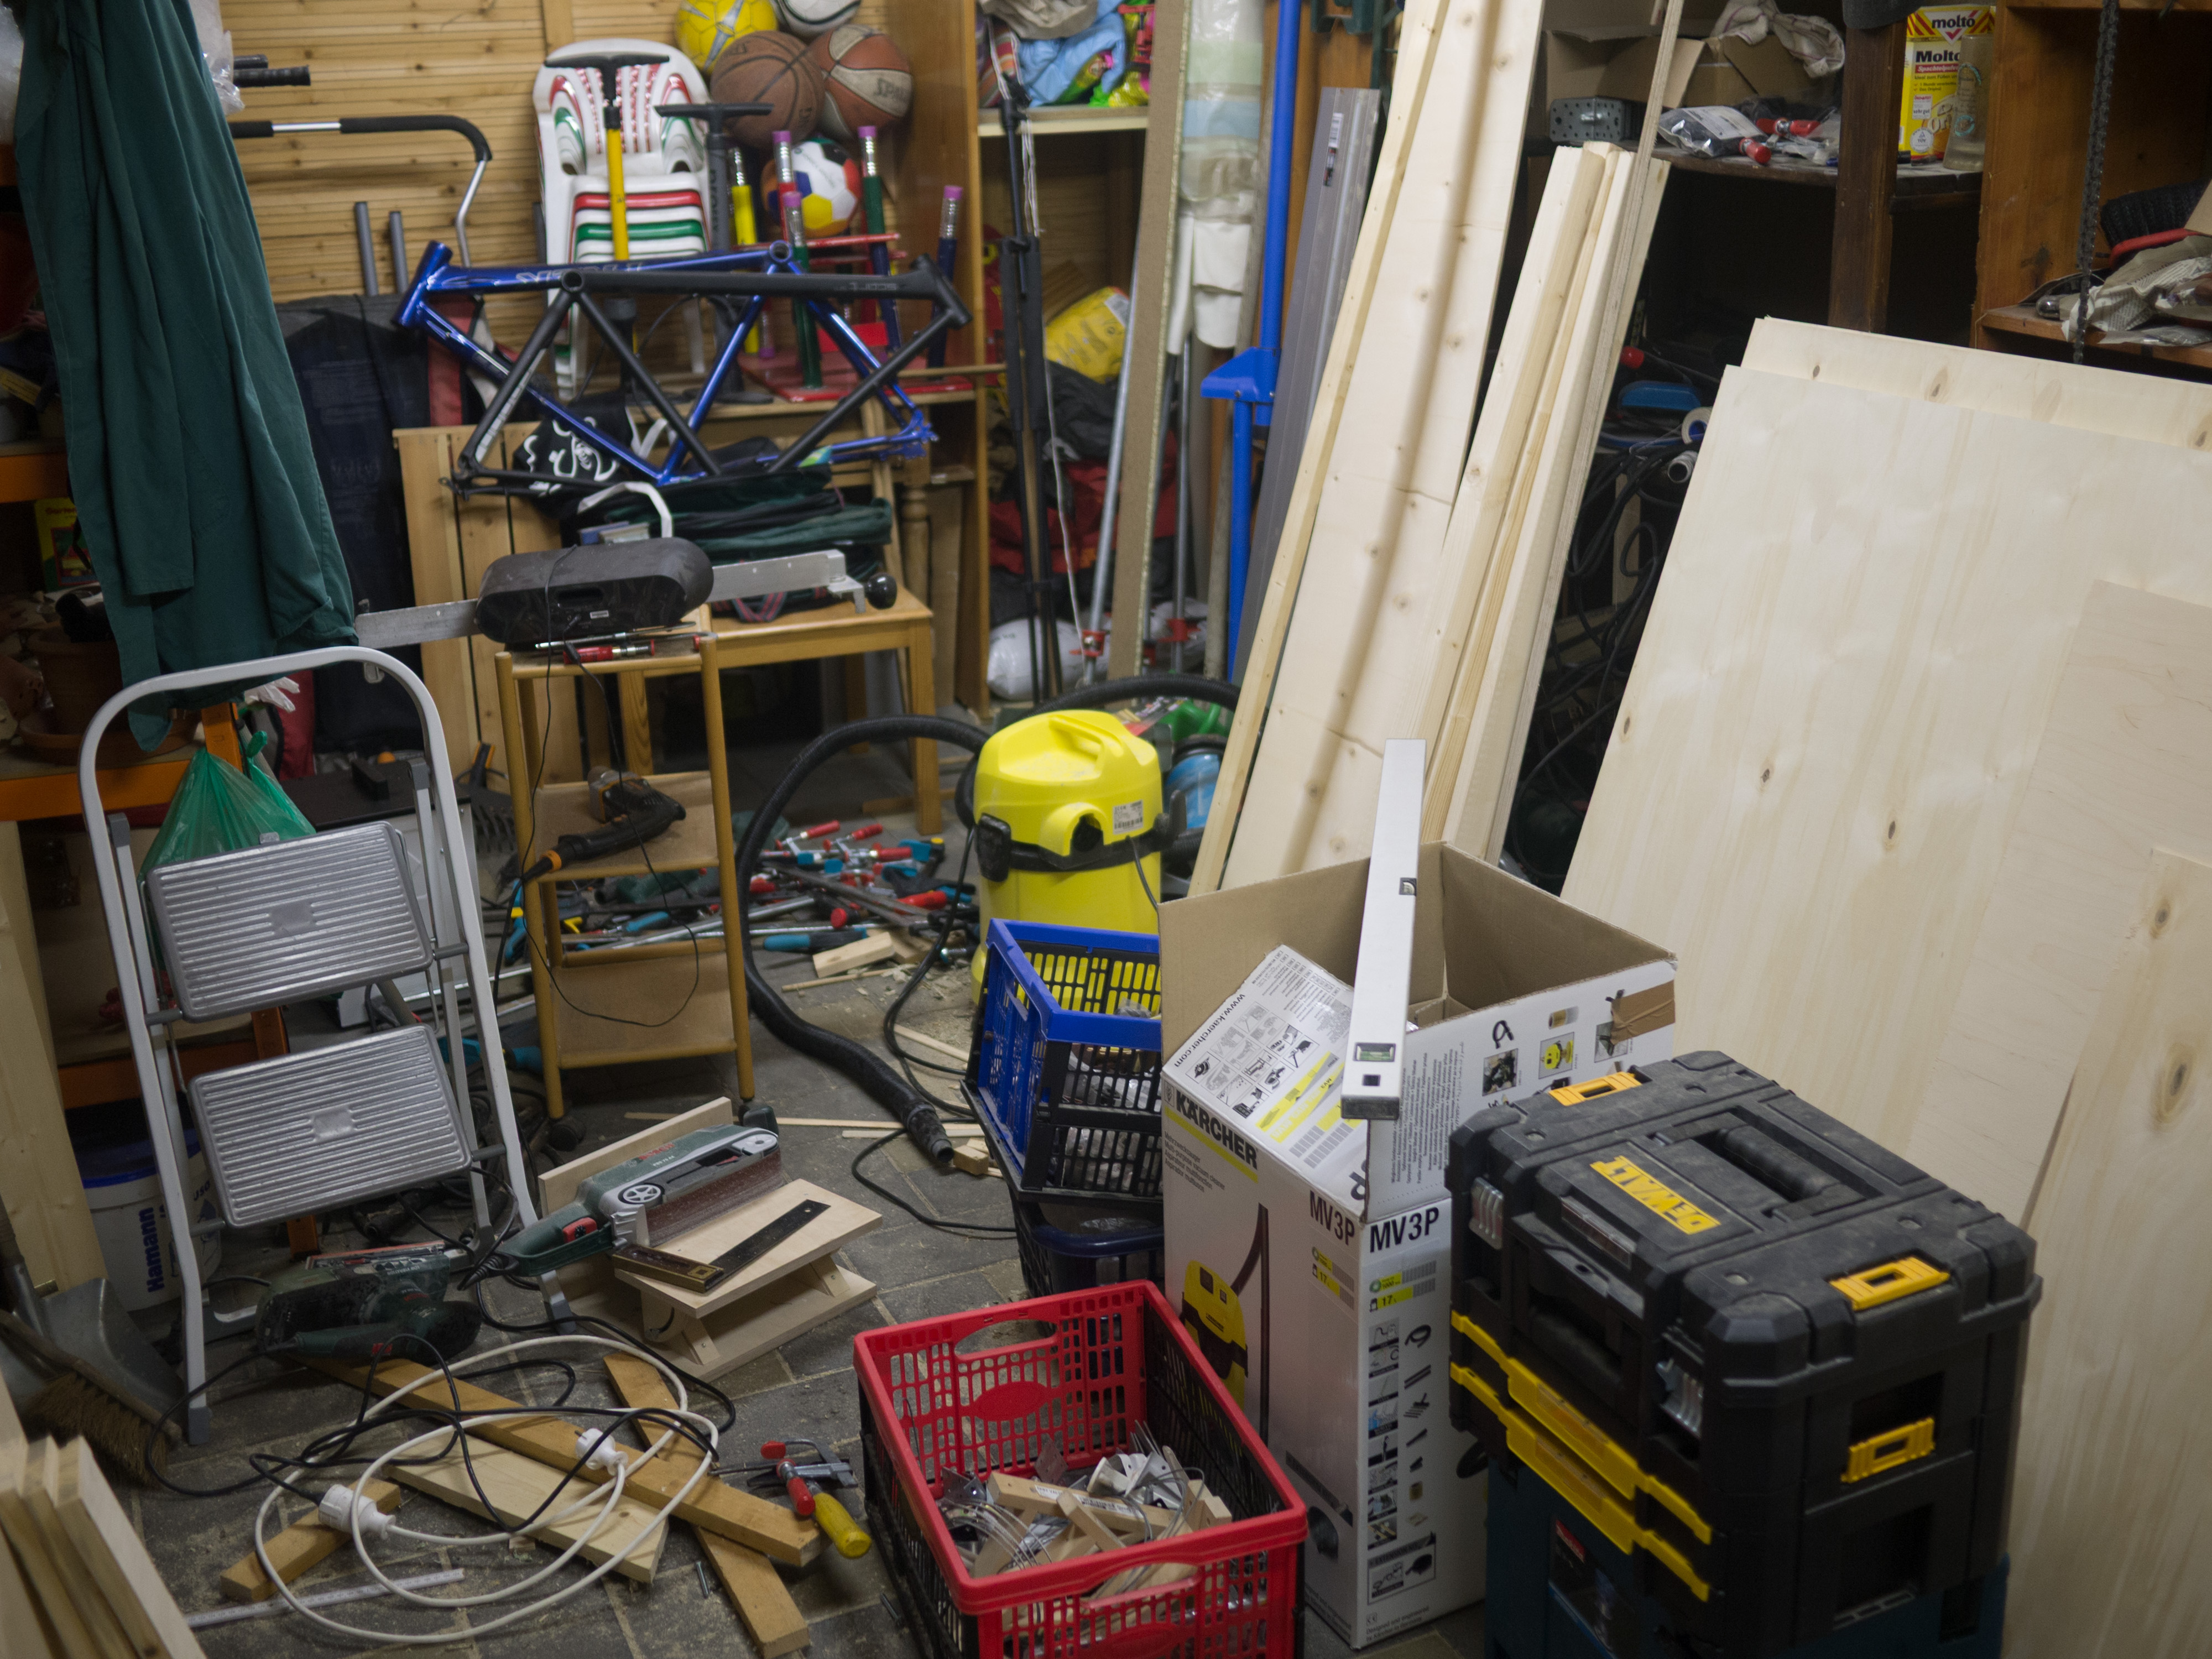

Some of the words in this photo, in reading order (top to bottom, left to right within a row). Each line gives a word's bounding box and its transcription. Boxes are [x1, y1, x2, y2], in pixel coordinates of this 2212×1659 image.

[1932, 14, 1975, 28] molto
[1173, 993, 1245, 1068] www.kaercher.com
[1176, 1089, 1258, 1171] KÄRCHER
[1310, 1190, 1355, 1245] MV3P
[1590, 1155, 1720, 1235] DEWALT
[138, 1207, 165, 1293] Hamann
[1369, 1206, 1439, 1254] MV3P
[1383, 1295, 1393, 1306] 17
